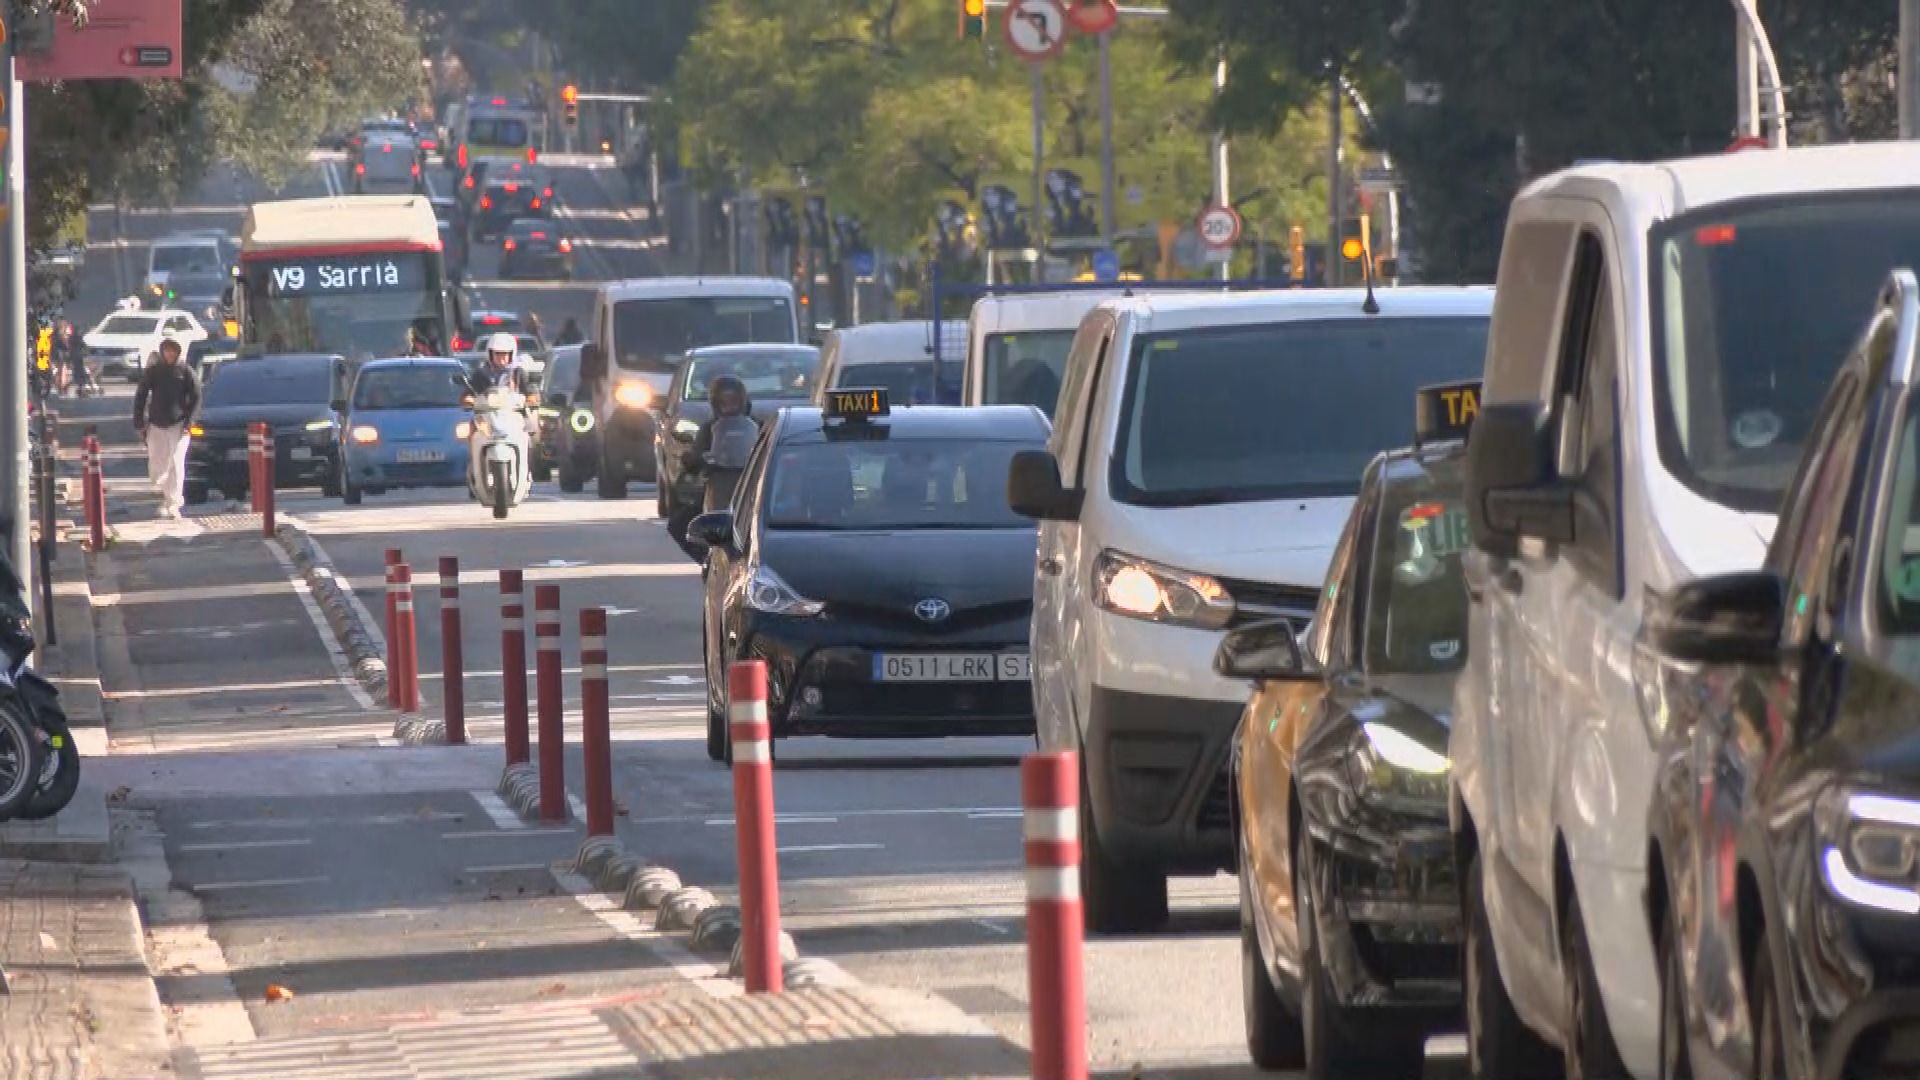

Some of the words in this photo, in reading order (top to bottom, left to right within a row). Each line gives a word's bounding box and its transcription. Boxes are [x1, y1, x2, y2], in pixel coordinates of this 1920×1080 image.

[272, 266, 305, 290] V9
[318, 260, 399, 288] Sarrià
[835, 394, 869, 412] TAXI
[887, 657, 938, 677] 0511
[949, 657, 988, 677] LRK
